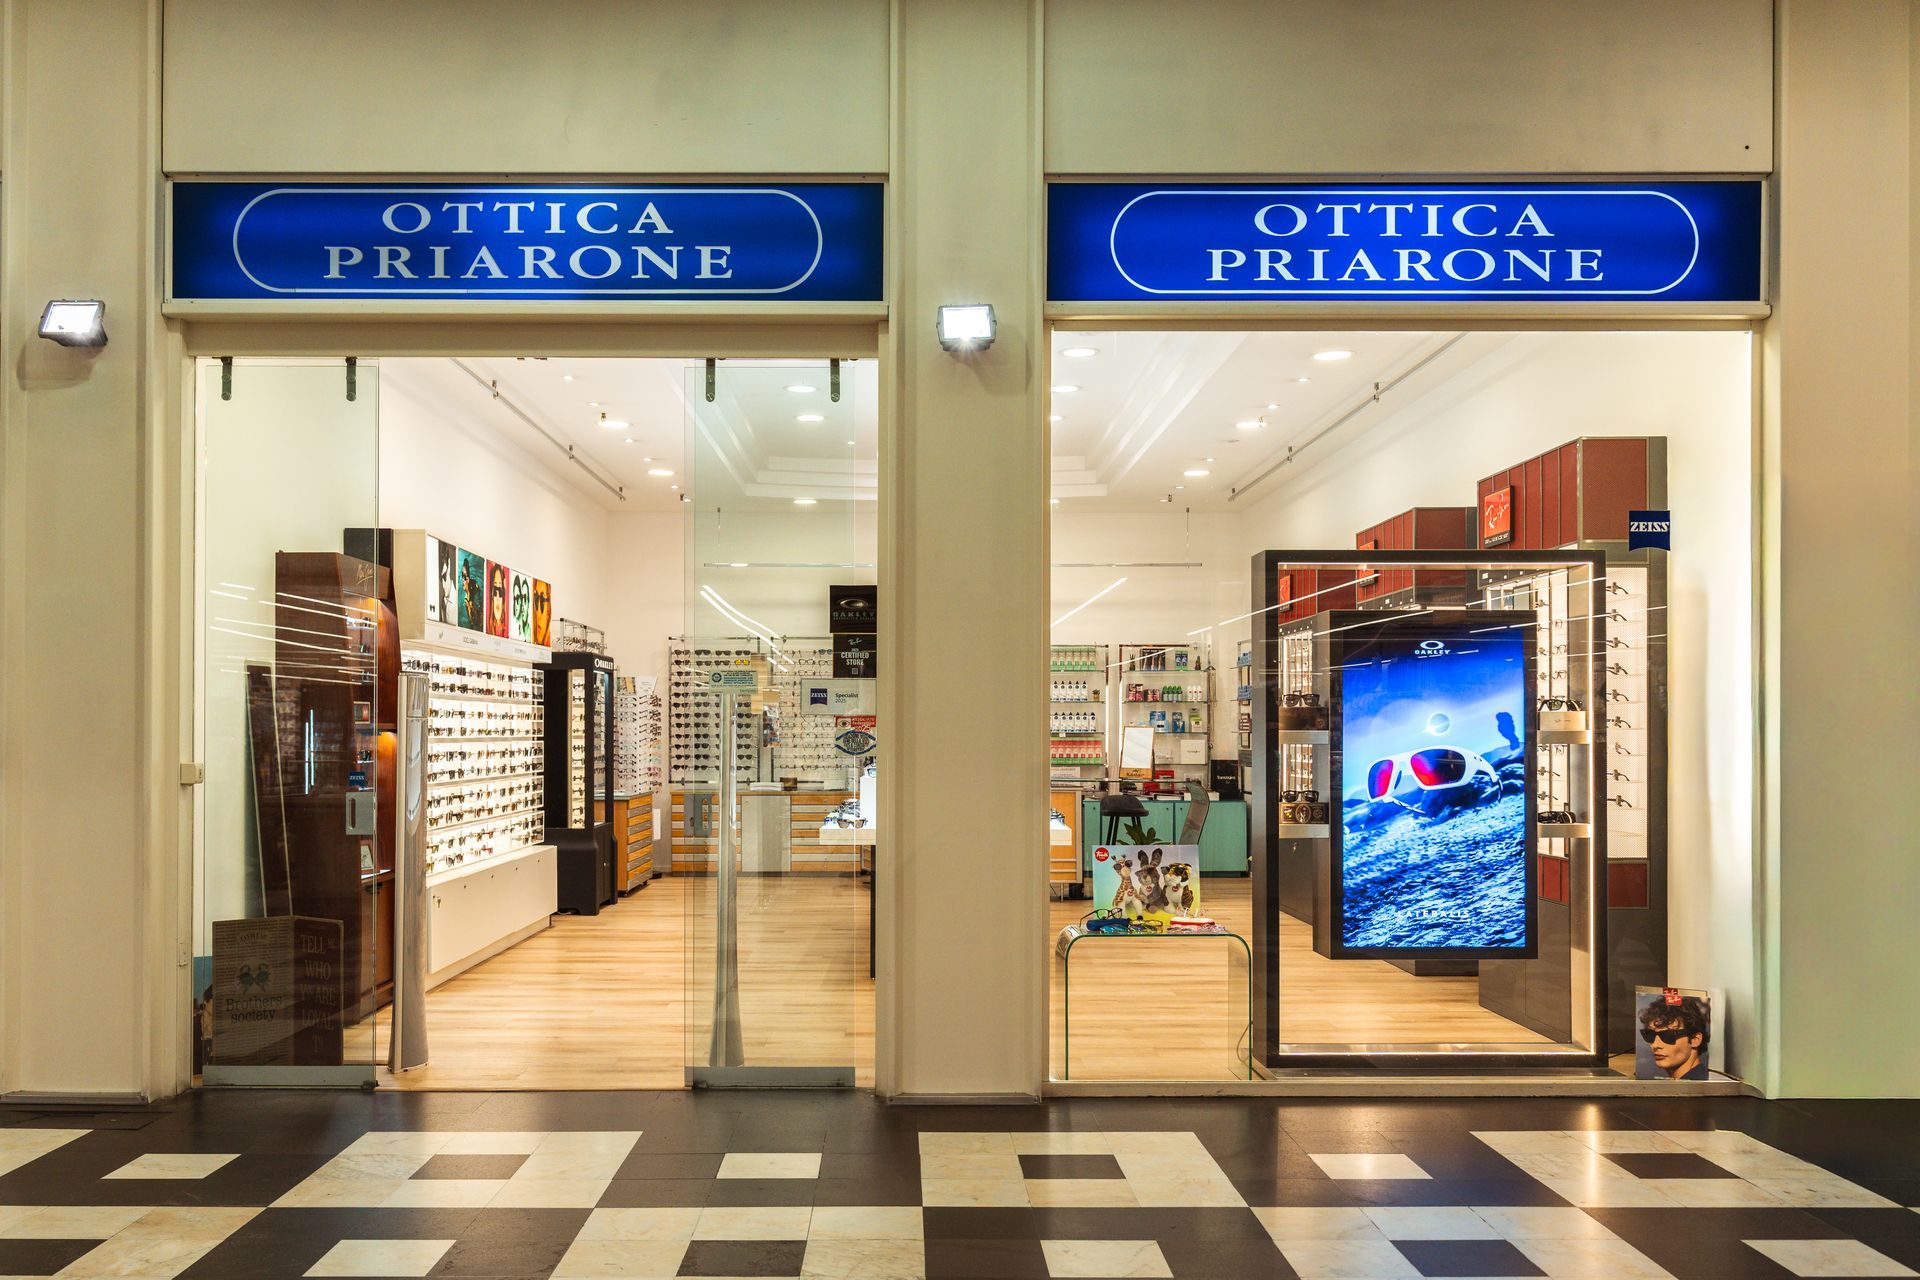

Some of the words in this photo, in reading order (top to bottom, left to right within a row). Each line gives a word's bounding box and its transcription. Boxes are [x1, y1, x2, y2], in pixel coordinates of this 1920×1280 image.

[382, 201, 673, 234] OTTICA
[1254, 203, 1555, 237] OTTICA
[324, 245, 733, 279] PRIARONE
[1206, 248, 1604, 282] PRIARONE
[1630, 521, 1670, 532] ZEISS
[841, 651, 870, 659] CERTIFIED
[301, 934, 327, 955] TELL
[304, 959, 331, 981] WHO
[225, 995, 282, 1012] Brothers
[315, 985, 337, 1007] ARE
[231, 1007, 276, 1024] society
[302, 1008, 335, 1031] LOYAL
